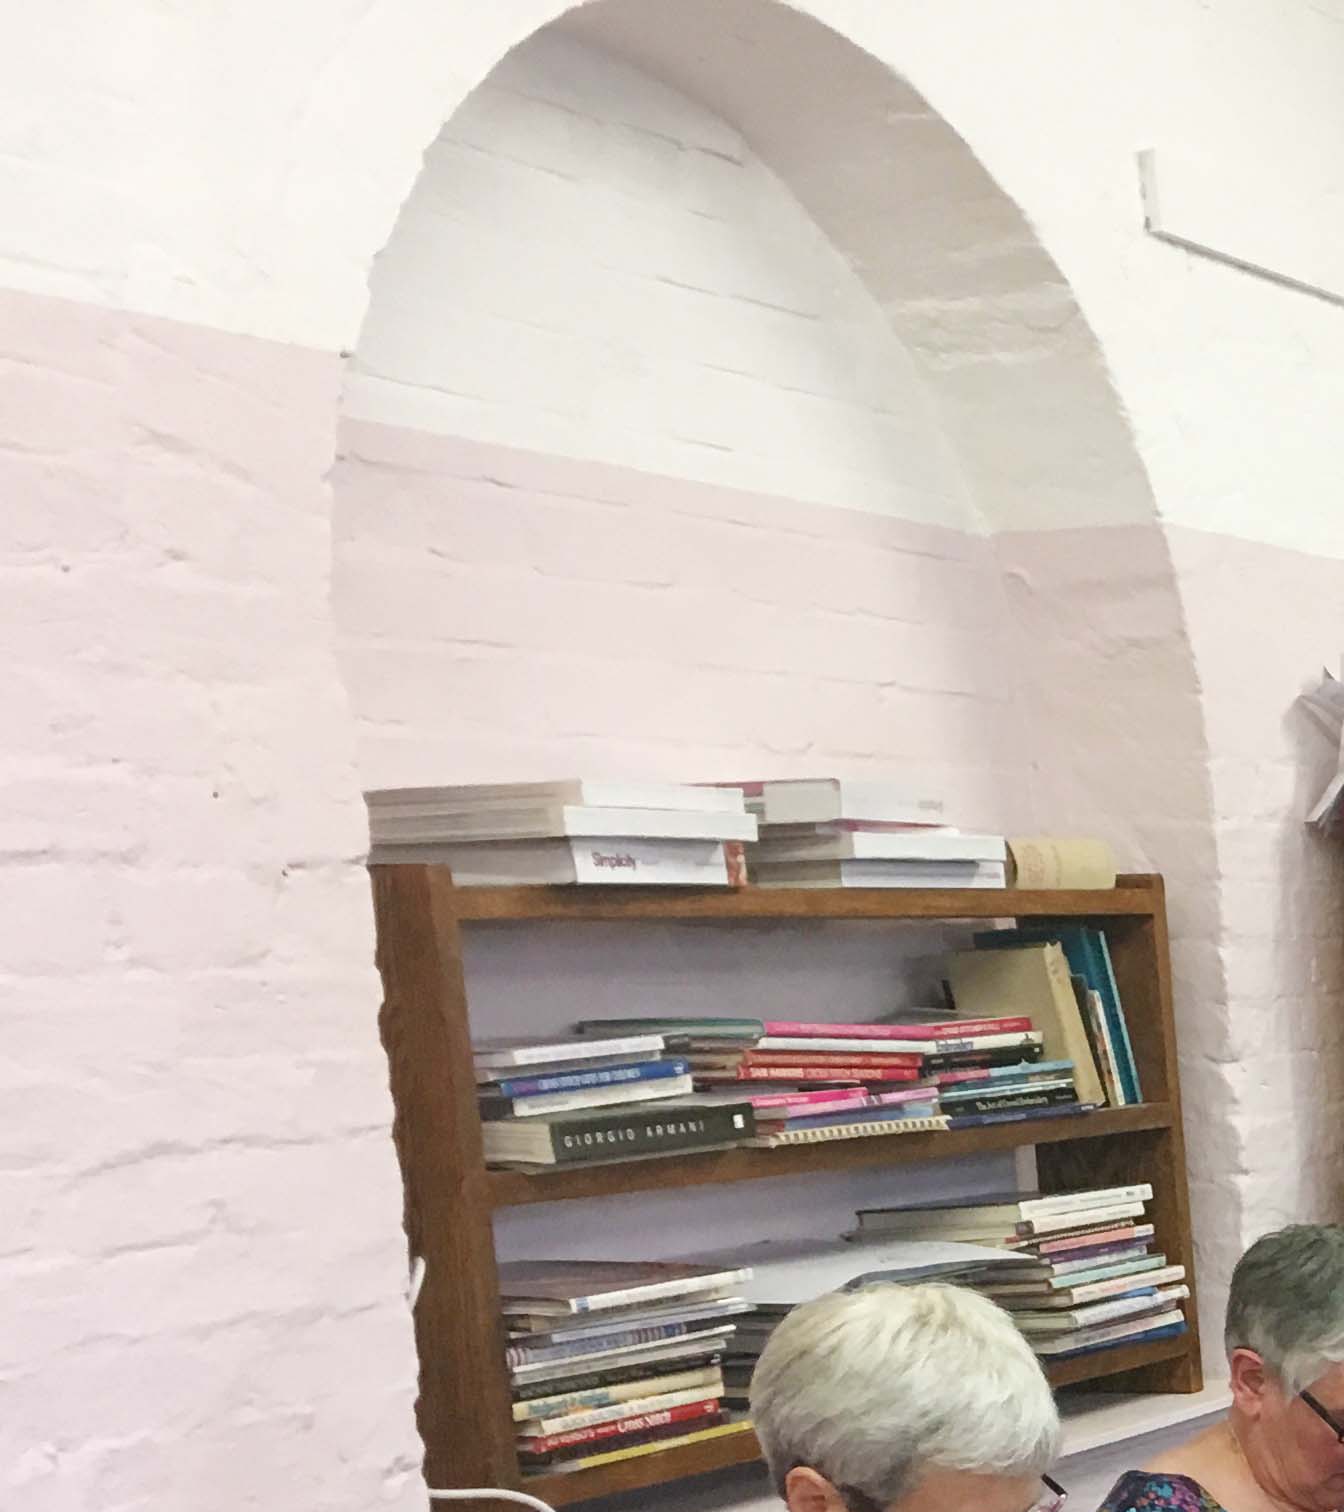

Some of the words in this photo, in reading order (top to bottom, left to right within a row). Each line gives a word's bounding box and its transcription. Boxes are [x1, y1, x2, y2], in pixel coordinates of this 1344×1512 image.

[591, 852, 637, 870] Simplicity
[563, 1128, 636, 1148] GIORGIO
[646, 1120, 705, 1138] ARMANI
